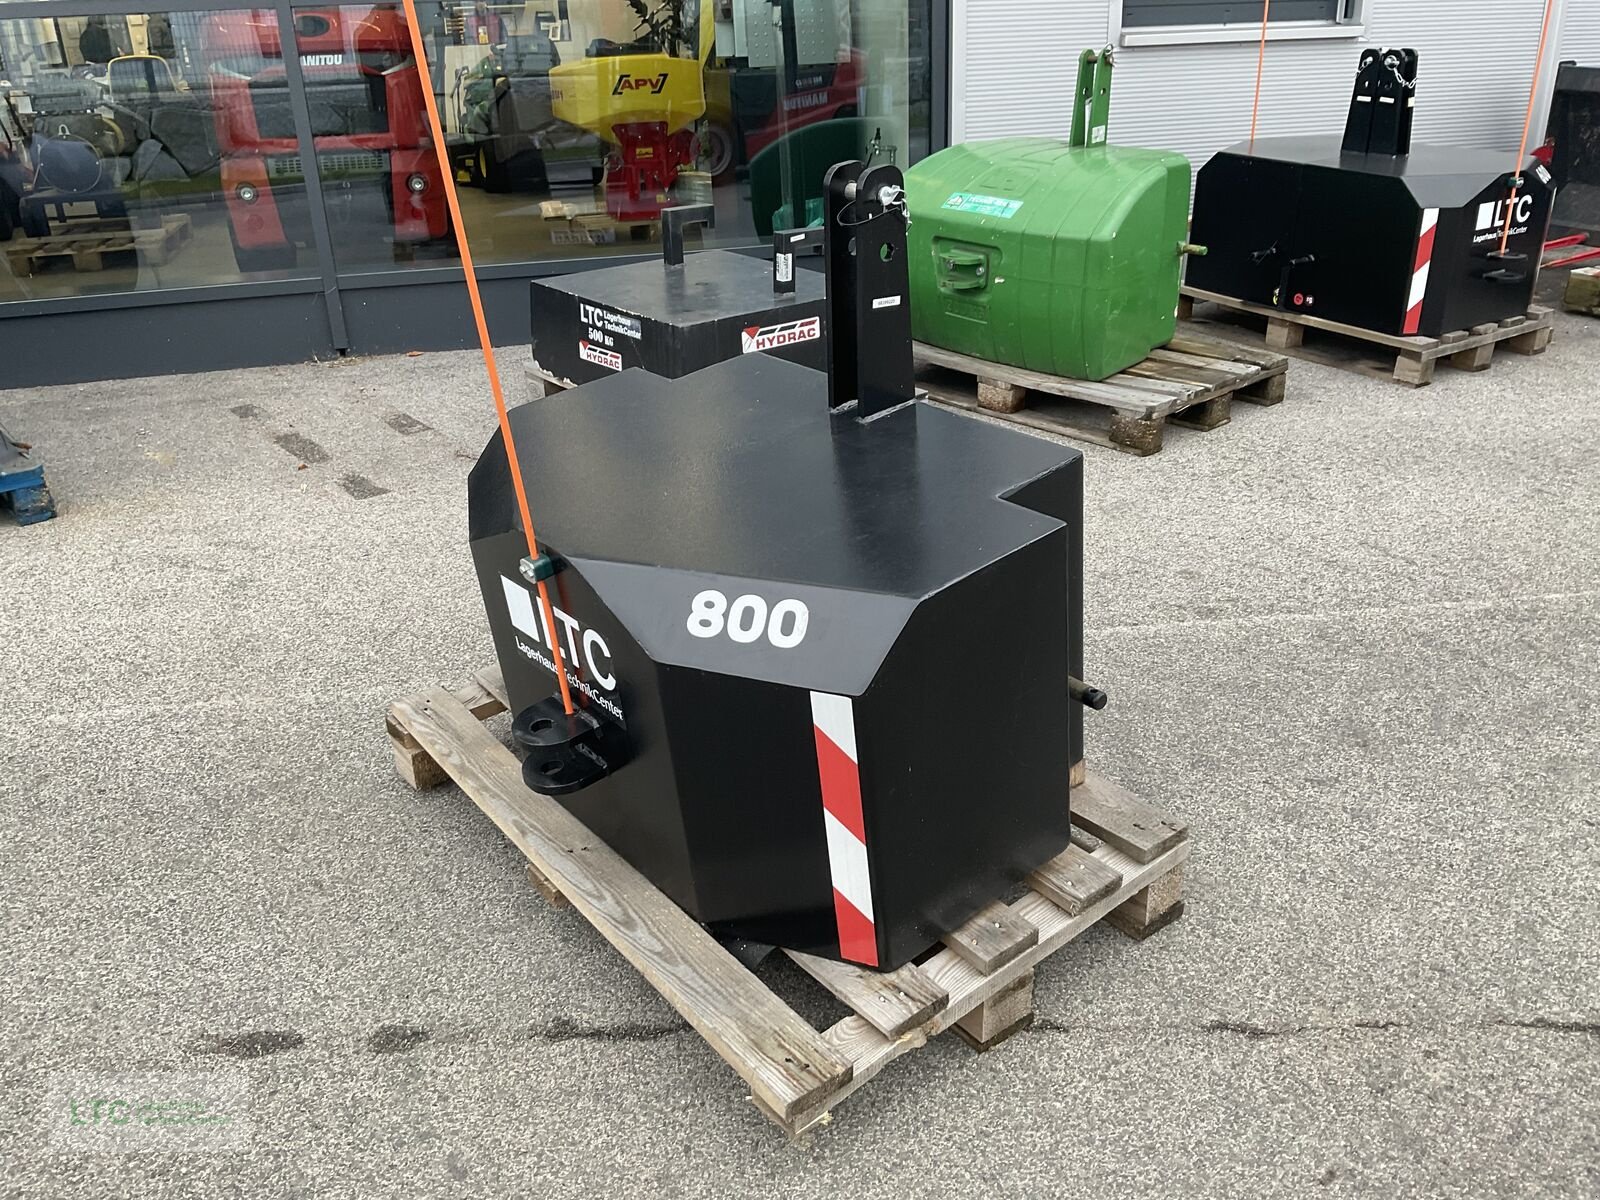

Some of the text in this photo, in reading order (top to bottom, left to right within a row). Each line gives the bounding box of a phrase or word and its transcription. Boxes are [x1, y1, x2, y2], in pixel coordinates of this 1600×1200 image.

[301, 54, 343, 66] ANITOU
[618, 78, 661, 91] APV
[1494, 194, 1533, 227] LTC
[580, 303, 603, 327] LTC
[588, 327, 614, 347] 500 KG
[756, 327, 816, 349] HYDRAC
[586, 351, 620, 369] HYDRAC
[686, 589, 809, 649] 800
[536, 595, 617, 691] LTC
